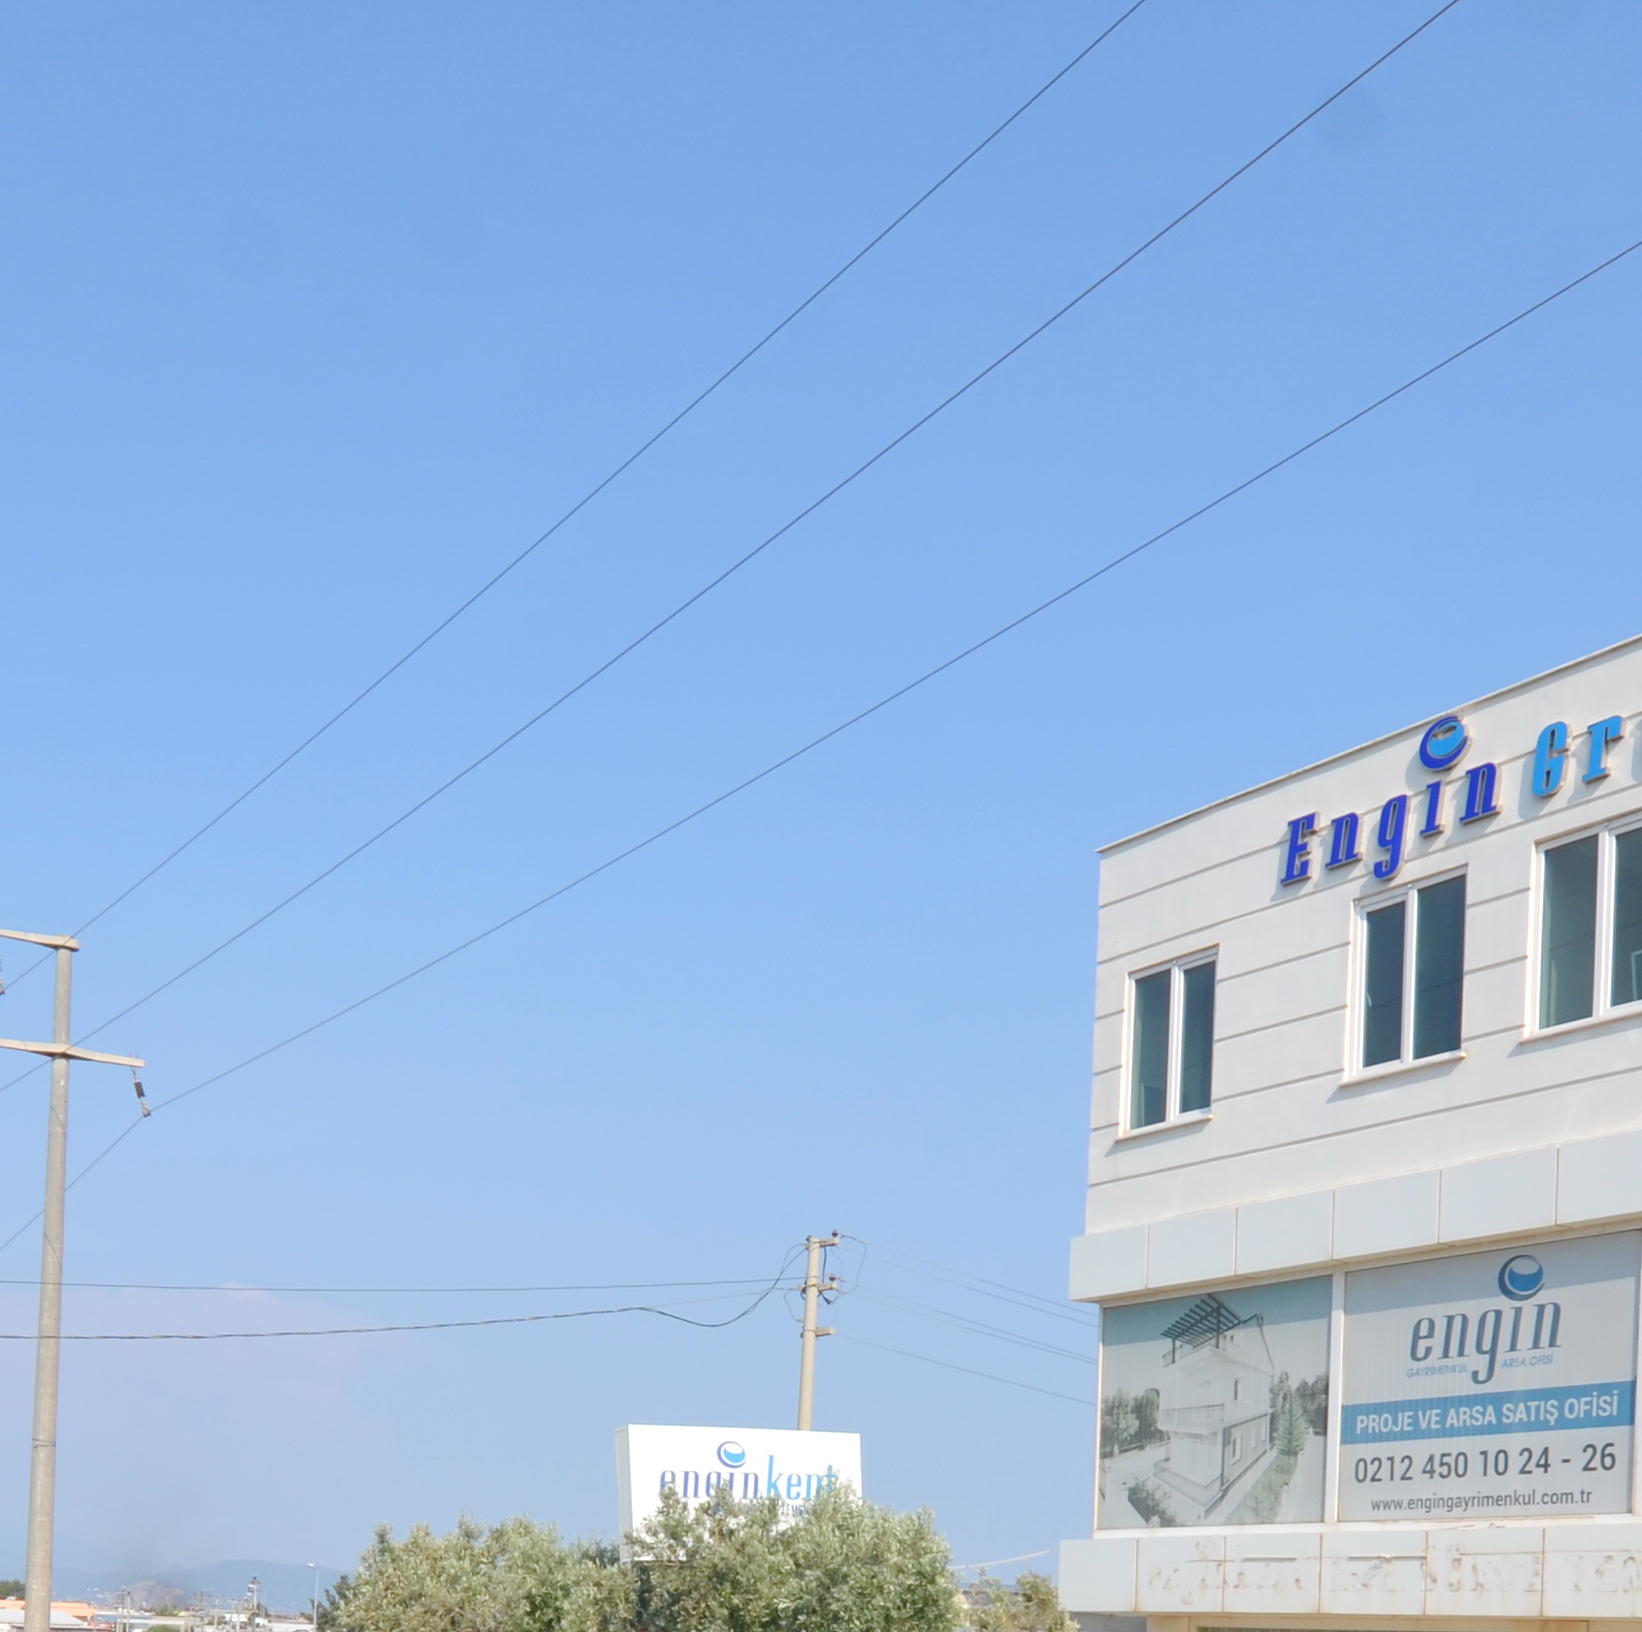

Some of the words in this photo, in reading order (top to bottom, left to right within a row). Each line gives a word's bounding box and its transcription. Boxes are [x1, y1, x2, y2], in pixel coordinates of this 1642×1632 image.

[1281, 714, 1503, 886] Engin
[1410, 1254, 1563, 1384] engin
[1407, 1362, 1469, 1379] GAYRİMENKUL
[1501, 1357, 1527, 1370] ARSA
[1528, 1353, 1554, 1367] OFİSİ
[1356, 1411, 1414, 1435] PROJE
[1418, 1408, 1442, 1430] VE
[1445, 1405, 1497, 1428] ARSA
[1501, 1399, 1559, 1426] SATIŞ
[1563, 1389, 1619, 1420] OFİSİ
[1354, 1454, 1414, 1483] 0212
[1421, 1451, 1469, 1480] 450
[1478, 1448, 1509, 1478] 10
[1518, 1446, 1552, 1475] 24
[1581, 1442, 1617, 1472] 26
[1370, 1488, 1593, 1514] www.engingayrimenkul.com.tr
